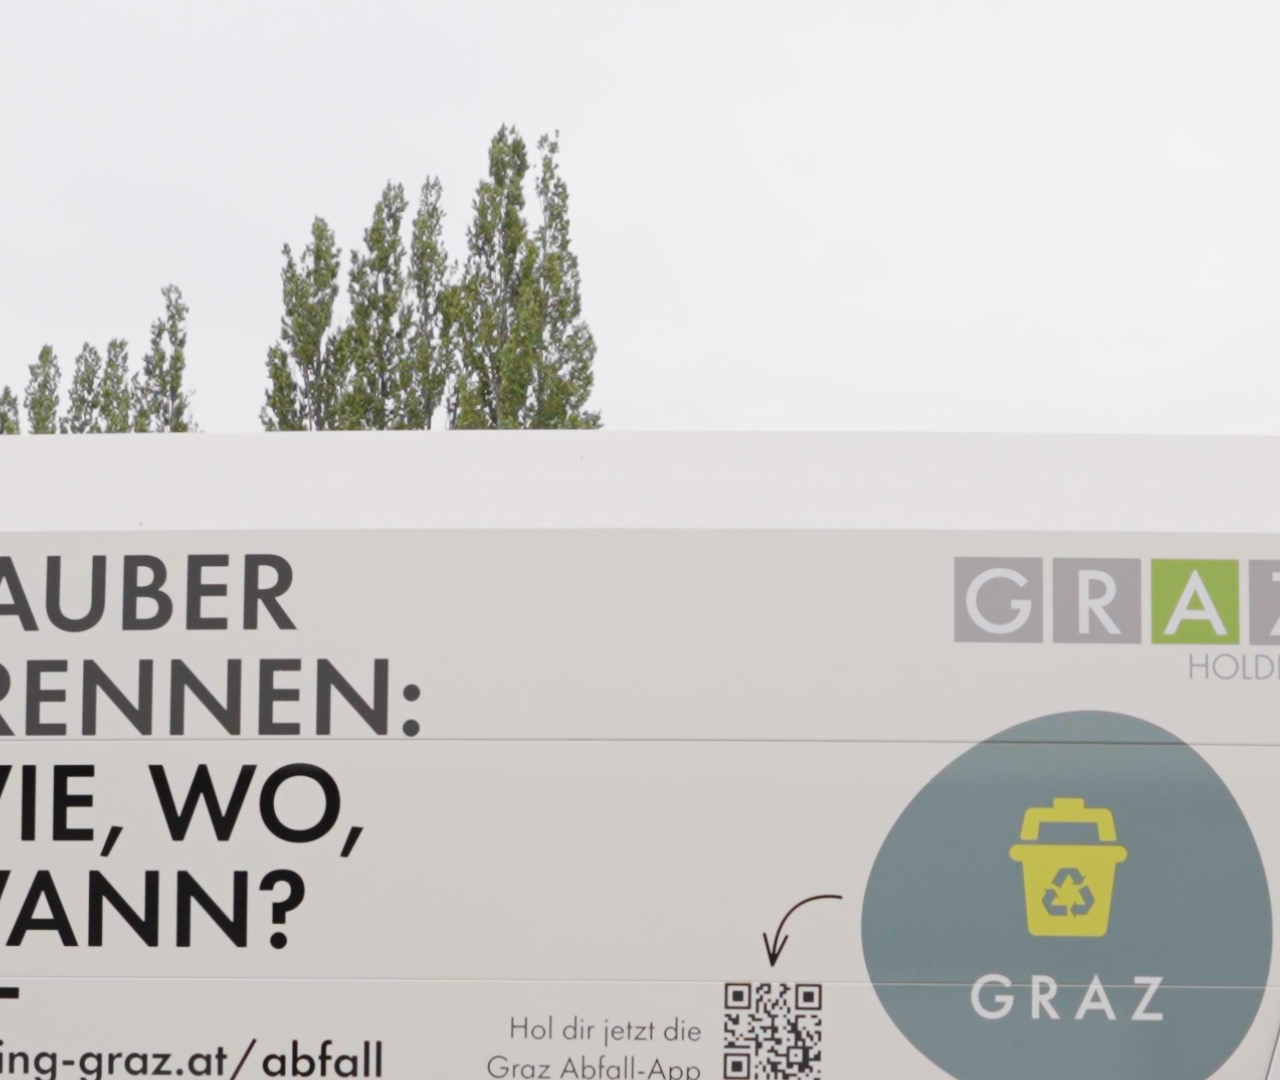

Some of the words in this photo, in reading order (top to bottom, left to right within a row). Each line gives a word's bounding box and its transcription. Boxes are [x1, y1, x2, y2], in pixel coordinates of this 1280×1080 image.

[148, 762, 364, 858] WO,
[970, 973, 1165, 1021] GRAZ
[510, 1015, 553, 1041] Hol
[562, 1015, 595, 1041] dir
[603, 1019, 655, 1048] jetzt
[663, 1016, 702, 1042] die
[486, 1055, 551, 1080] Graz
